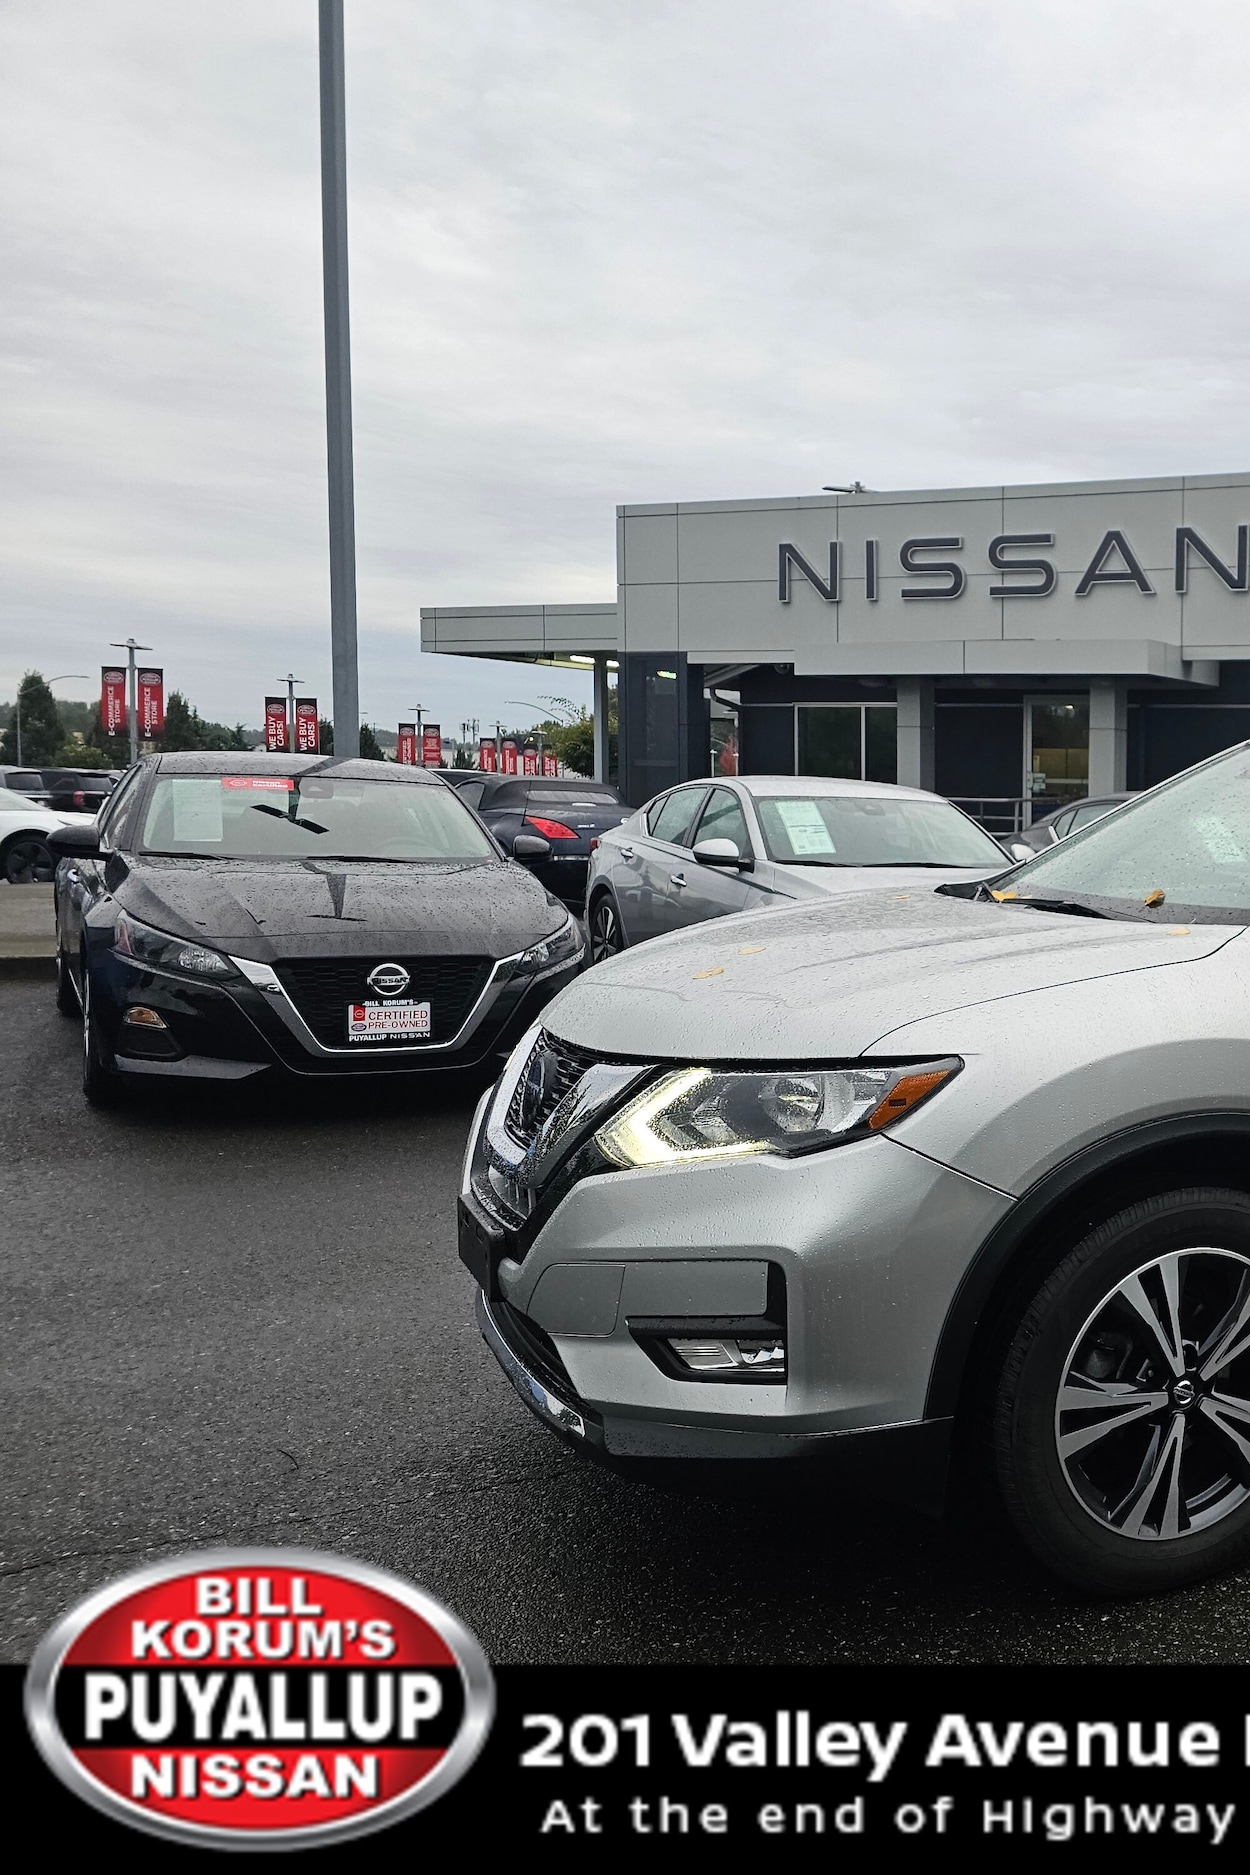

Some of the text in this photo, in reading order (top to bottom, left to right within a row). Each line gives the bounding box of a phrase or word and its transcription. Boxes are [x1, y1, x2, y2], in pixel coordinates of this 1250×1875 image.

[777, 523, 1250, 604] NISSAN
[268, 716, 276, 734] BUY
[299, 717, 307, 751] WE BUY
[307, 722, 315, 747] CARS!
[269, 736, 276, 750] WE
[368, 1010, 428, 1020] CERTIFIED
[368, 1020, 428, 1029] PRE-OWNED
[349, 1032, 430, 1041] PUYALLUP NISSAN
